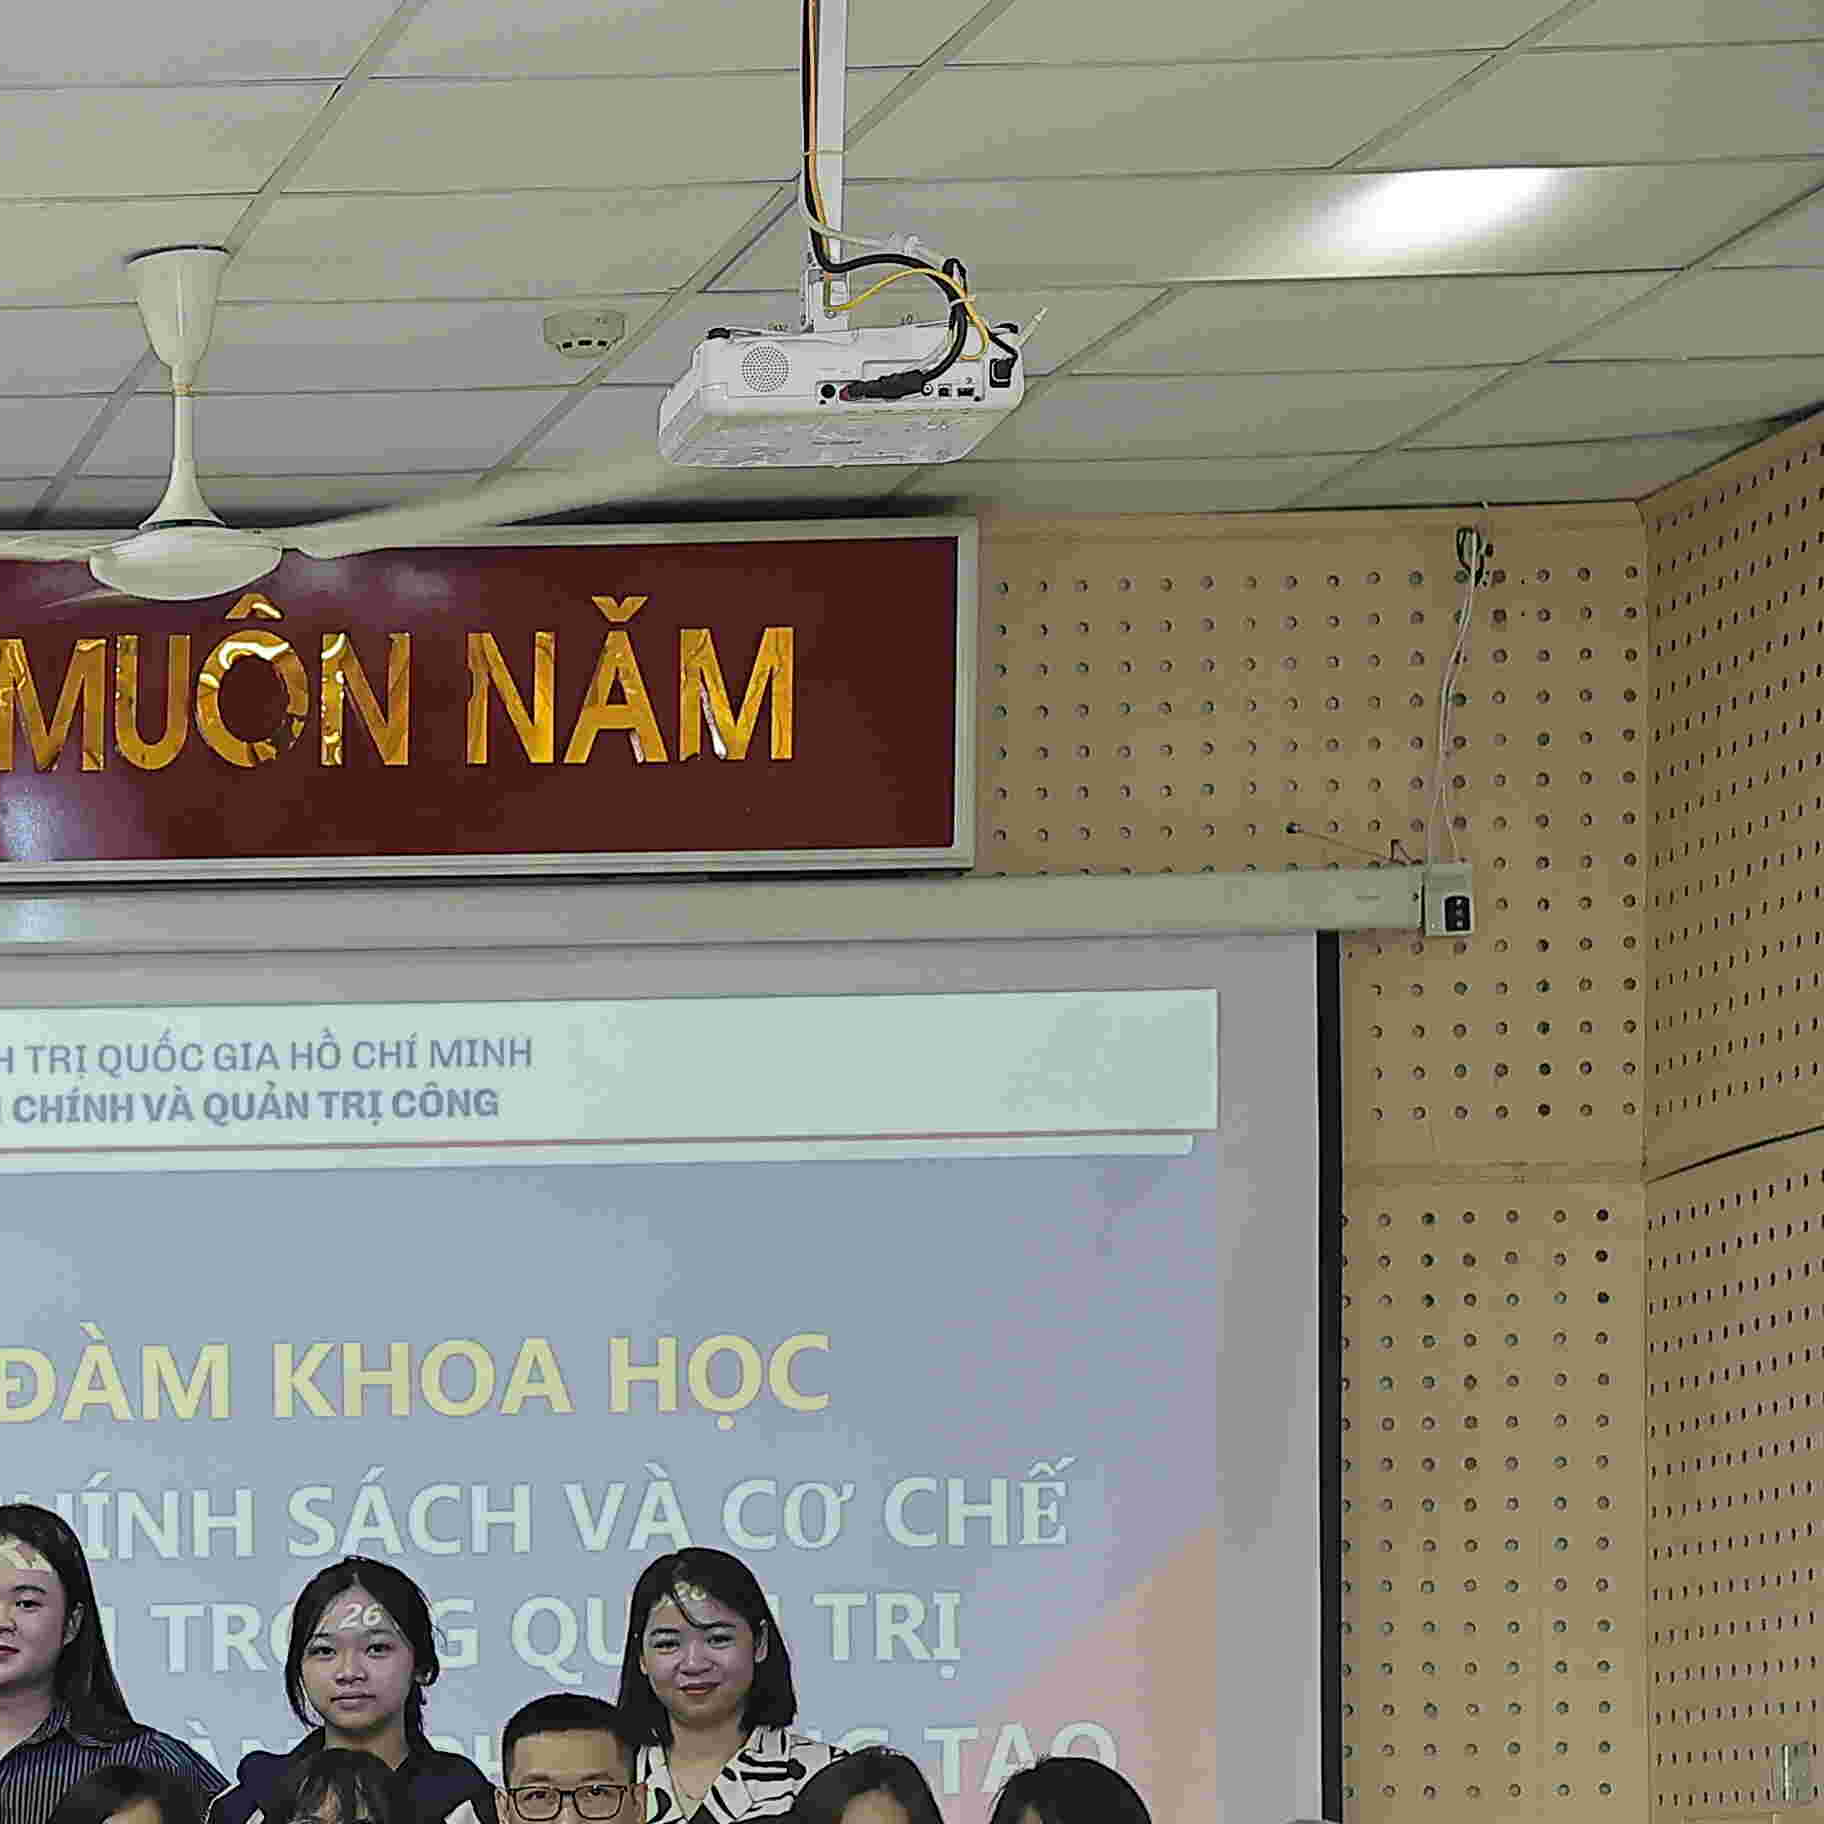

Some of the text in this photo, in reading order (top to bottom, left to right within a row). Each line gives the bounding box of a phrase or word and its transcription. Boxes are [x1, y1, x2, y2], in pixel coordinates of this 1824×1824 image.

[465, 594, 796, 765] NĂM
[25, 1045, 87, 1080] TRỊ
[97, 1028, 205, 1078] QUỐC
[213, 1043, 279, 1072] GIA
[290, 1027, 341, 1071] HỒ
[353, 1032, 418, 1070] CHÍ
[429, 1038, 533, 1068] MINH
[13, 1086, 134, 1124] CHÍNH
[139, 1086, 194, 1122] VÀ
[203, 1082, 311, 1126] QUẢN
[319, 1090, 382, 1126] TRỊ
[392, 1083, 500, 1120] CÔNG
[272, 1336, 574, 1418] KHOA
[608, 1334, 829, 1431] HỌC
[286, 1465, 529, 1557] SÁCH
[563, 1463, 694, 1552] VÀ
[720, 1478, 857, 1549] CƠ
[882, 1456, 1077, 1547] CHẾ
[150, 1598, 479, 1674] TRG
[813, 1589, 963, 1681] TRỊ
